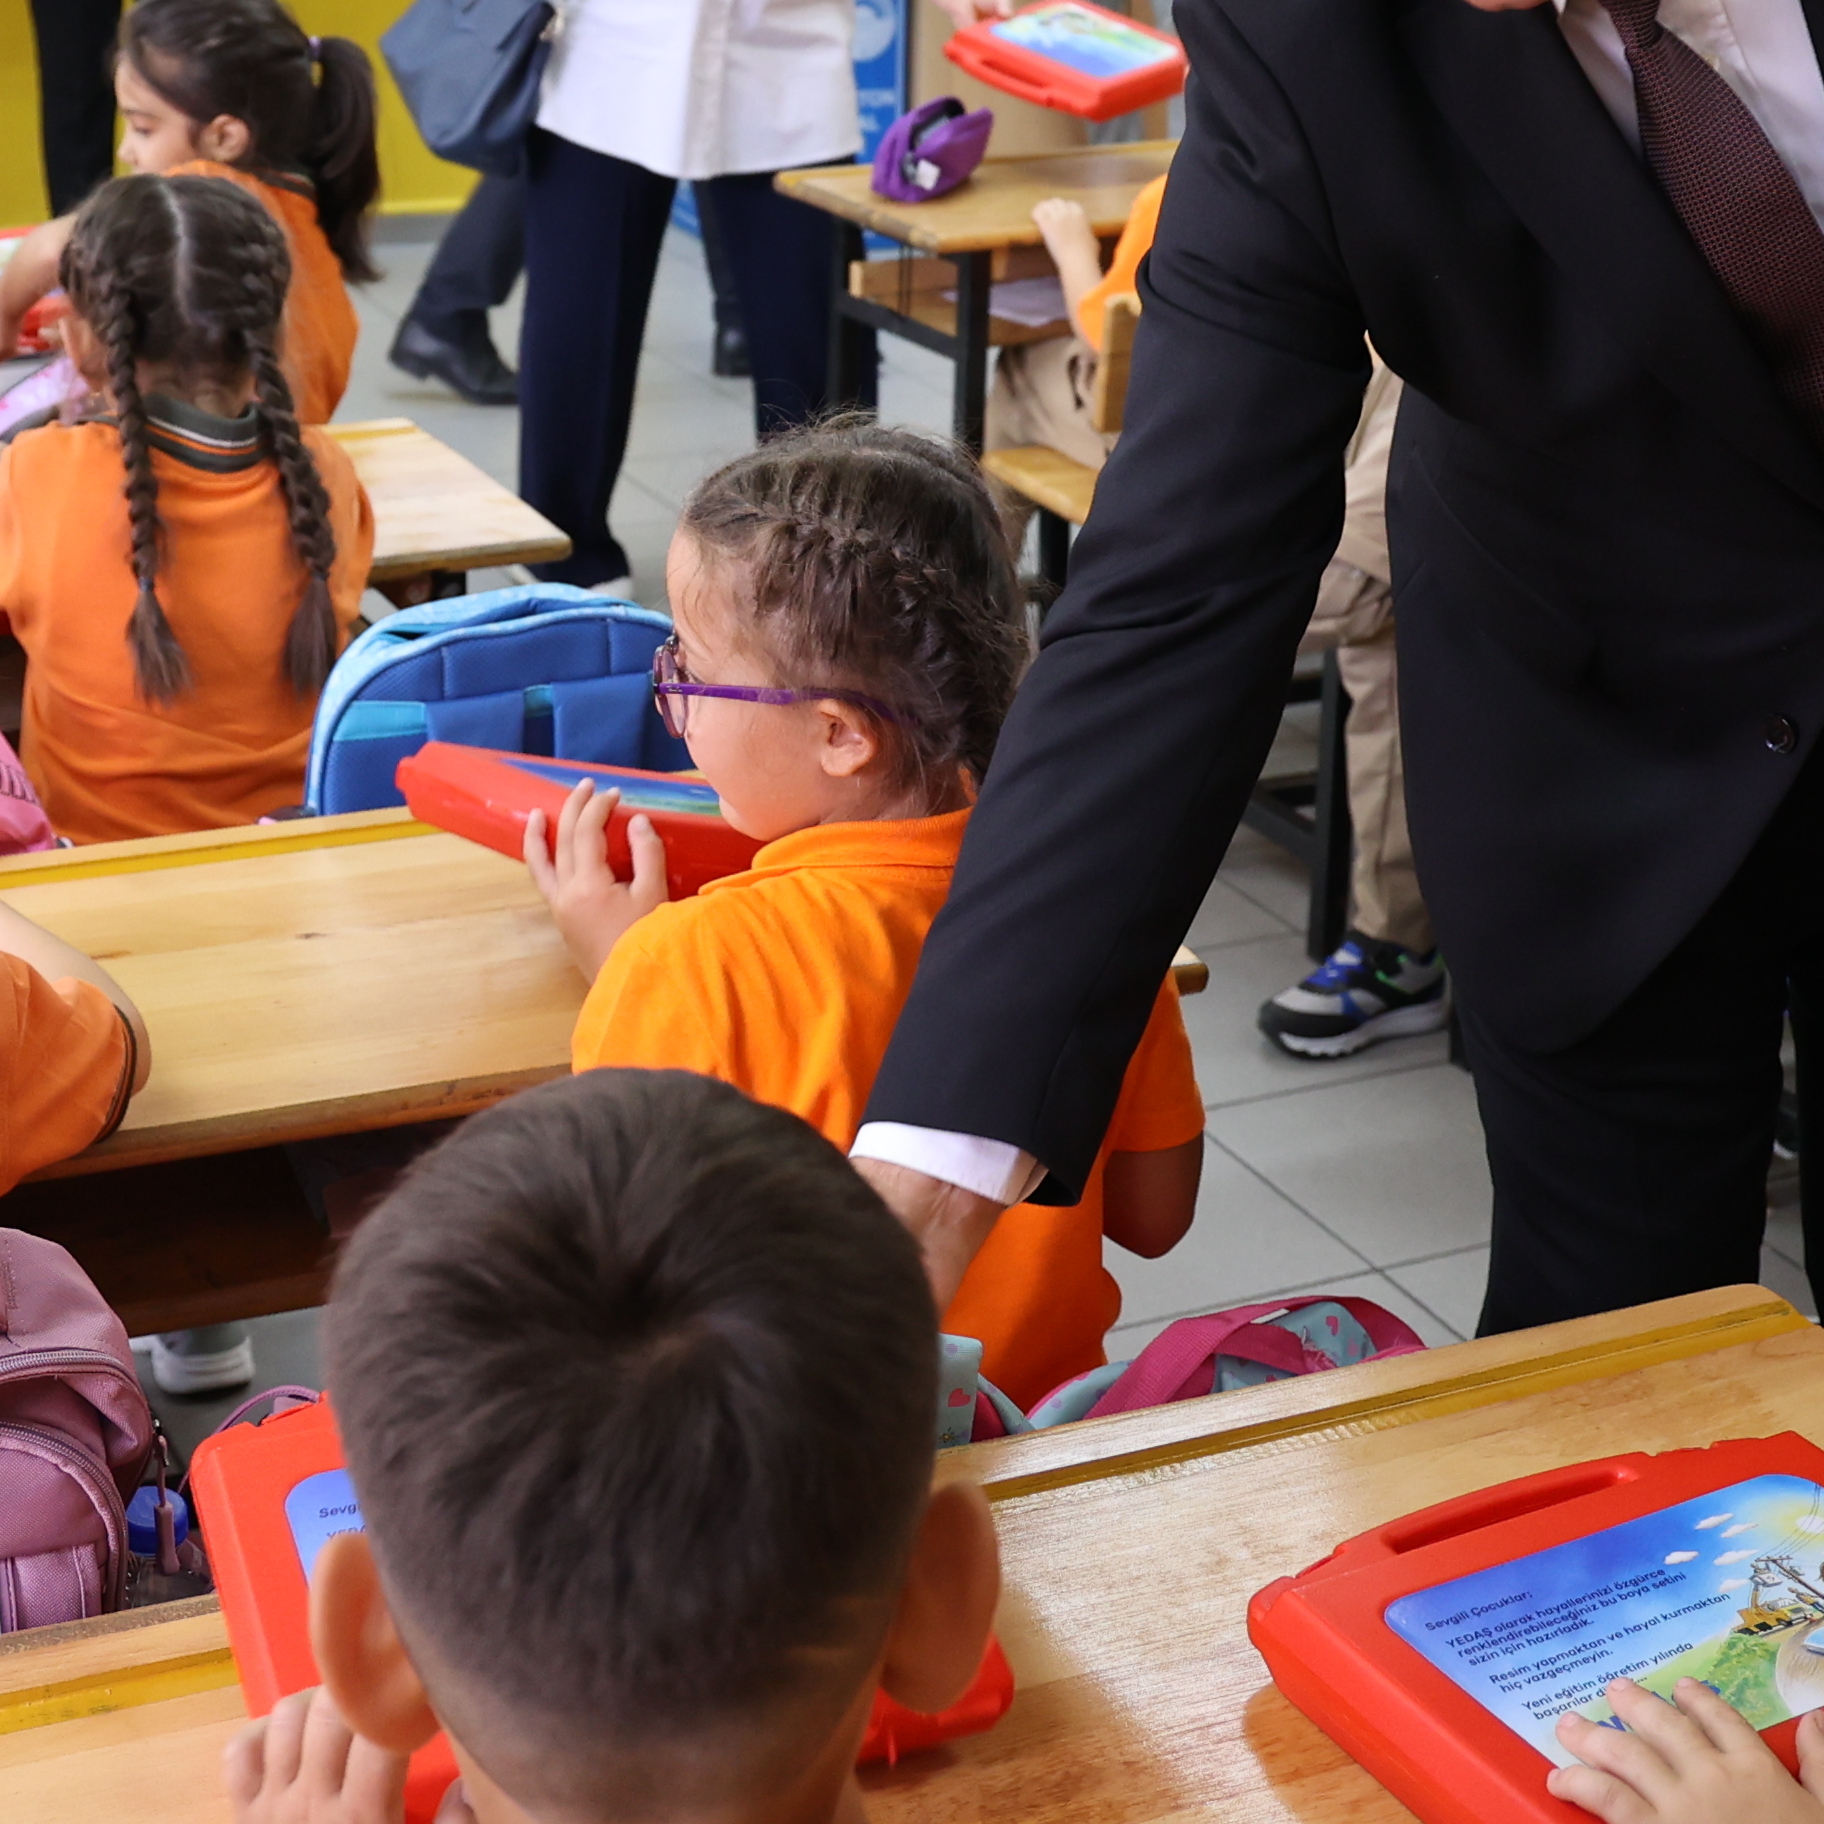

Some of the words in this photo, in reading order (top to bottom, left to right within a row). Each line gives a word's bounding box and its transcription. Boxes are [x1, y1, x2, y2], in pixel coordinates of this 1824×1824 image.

[1425, 1610, 1470, 1631] Sevgili
[1470, 1591, 1533, 1617] Çocuklar;
[1445, 1627, 1493, 1649] YEDAŞ
[1494, 1614, 1535, 1633] olarak
[1536, 1585, 1613, 1618] hayallerinizi
[1614, 1568, 1666, 1591] özgürce
[1457, 1604, 1599, 1658] renklendirebileceğiniz
[1599, 1597, 1618, 1608] bu
[1618, 1586, 1651, 1600] boya
[1651, 1572, 1687, 1589] setini
[1469, 1650, 1500, 1666] sizin
[1500, 1641, 1525, 1656] için
[1526, 1618, 1595, 1647] hazırladık.
[1489, 1665, 1531, 1684] Resim
[1532, 1638, 1607, 1671] yapmaktan
[1606, 1631, 1624, 1641] ve
[1623, 1616, 1661, 1635] hayal
[1661, 1593, 1731, 1620] kurmaktan
[1499, 1679, 1523, 1693] hiç
[1523, 1649, 1614, 1685] vazgeçmeyin.
[1521, 1694, 1552, 1710] Yeni
[1554, 1679, 1597, 1699] eğitim
[1597, 1660, 1649, 1683] öğretim
[1649, 1643, 1693, 1664] yılında
[1533, 1692, 1594, 1721] başarılar
